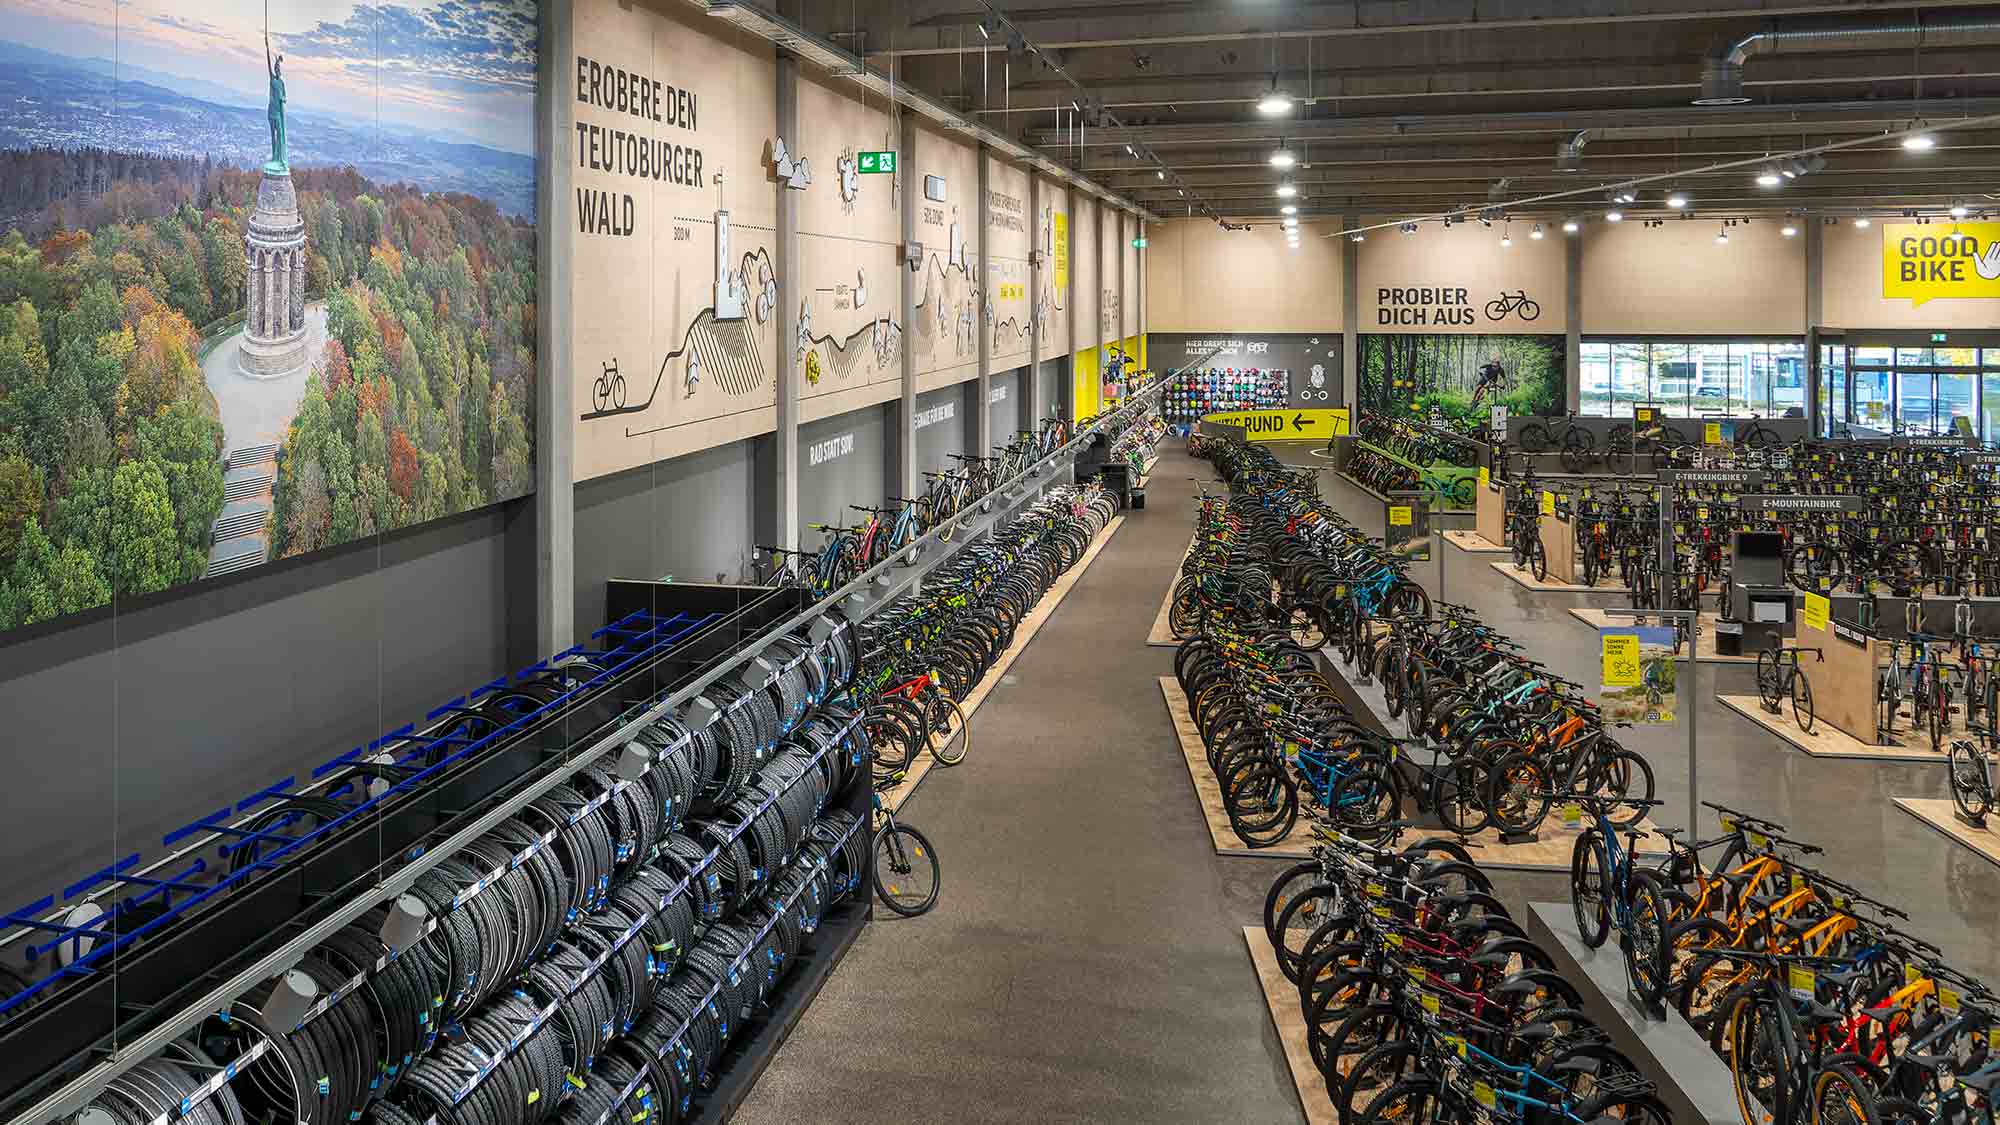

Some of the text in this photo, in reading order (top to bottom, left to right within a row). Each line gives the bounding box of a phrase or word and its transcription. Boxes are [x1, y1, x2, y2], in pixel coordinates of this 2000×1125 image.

[577, 56, 698, 132] EROBERE DEN
[576, 121, 703, 188] TEUTOBURGER
[577, 187, 634, 237] WALD
[1901, 236, 1978, 258] GOOD
[1901, 260, 1966, 282] BIKE
[1378, 288, 1468, 306] PROBIER
[1378, 308, 1475, 325] DICH AUS
[1244, 415, 1284, 433] RUND
[810, 443, 823, 466] RAD
[823, 438, 840, 462] STATT
[1675, 473, 1741, 481] E-TREKKINGBIKE
[1763, 499, 1841, 508] E-MOUNTAINBIKE
